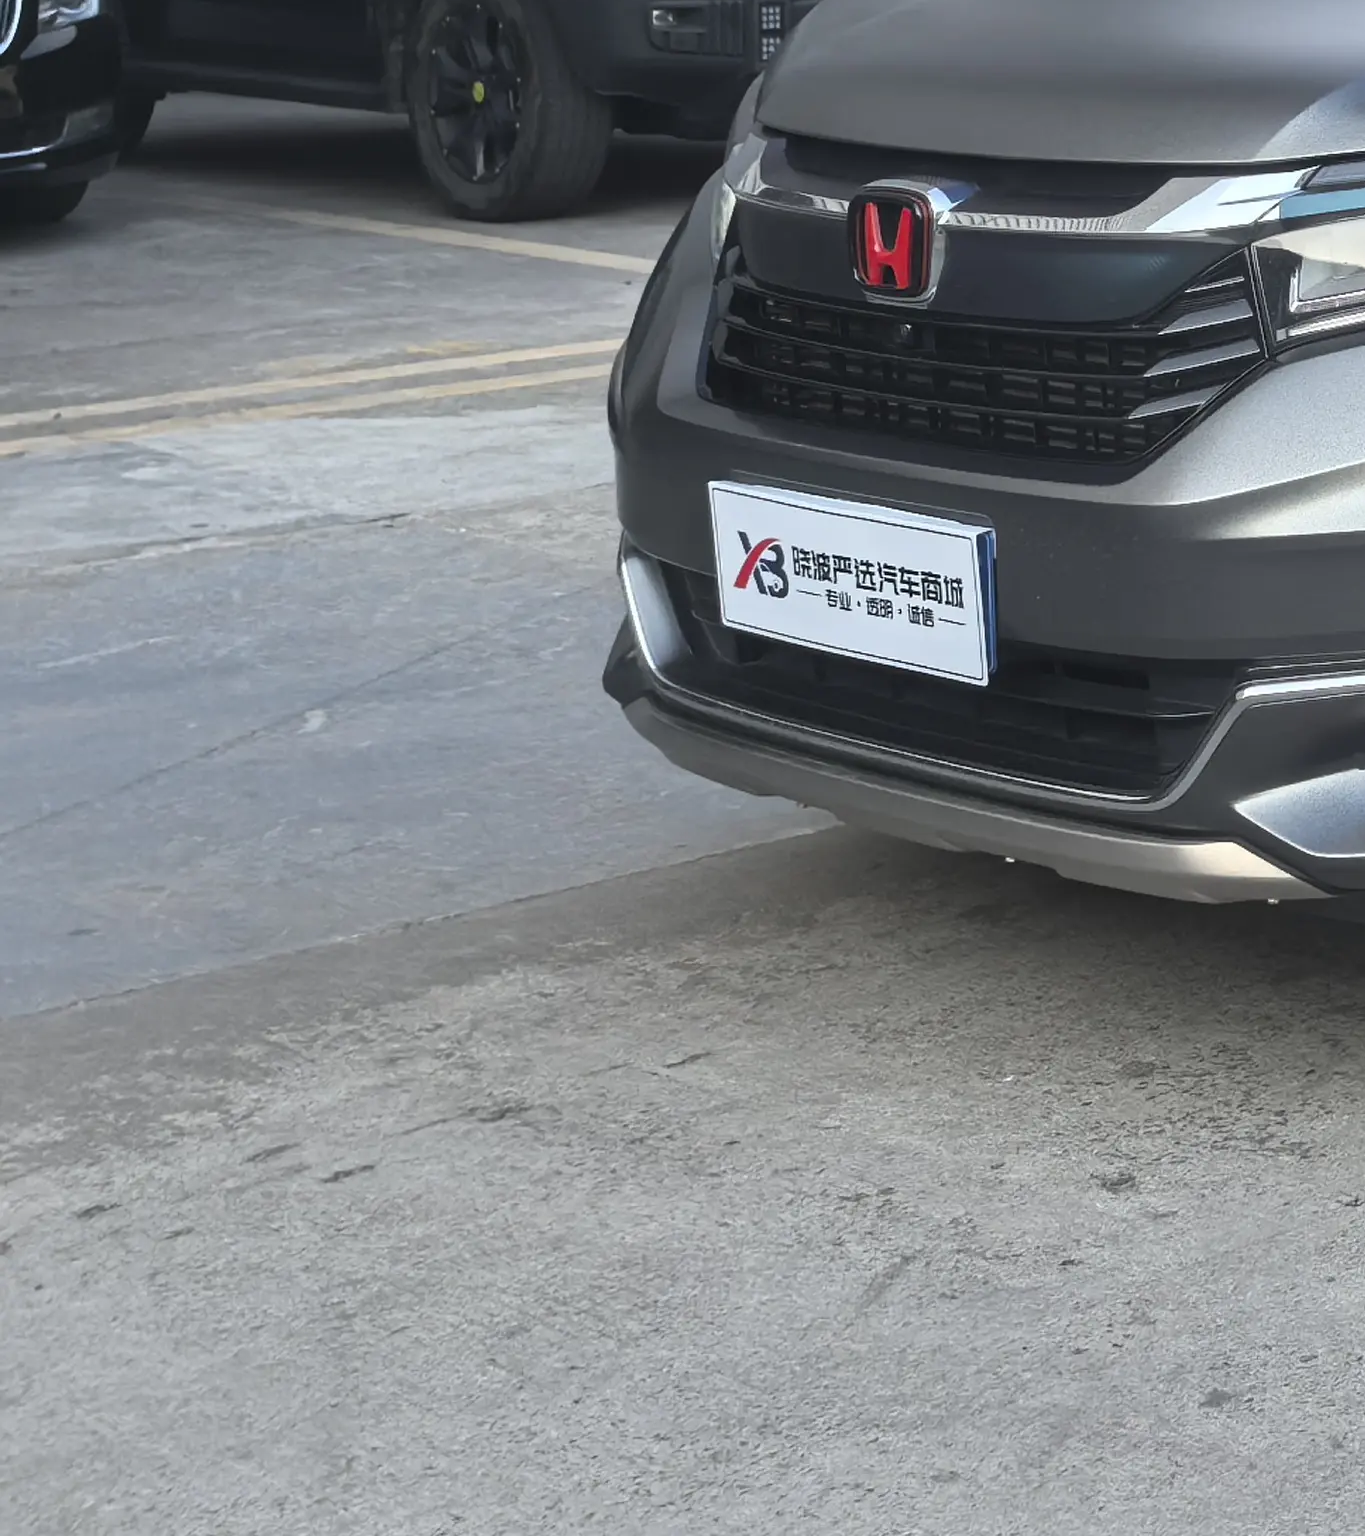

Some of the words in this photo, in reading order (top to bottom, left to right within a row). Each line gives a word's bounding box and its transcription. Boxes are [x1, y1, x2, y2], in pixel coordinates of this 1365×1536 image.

[790, 545, 965, 609] 晓波严选汽车商城
